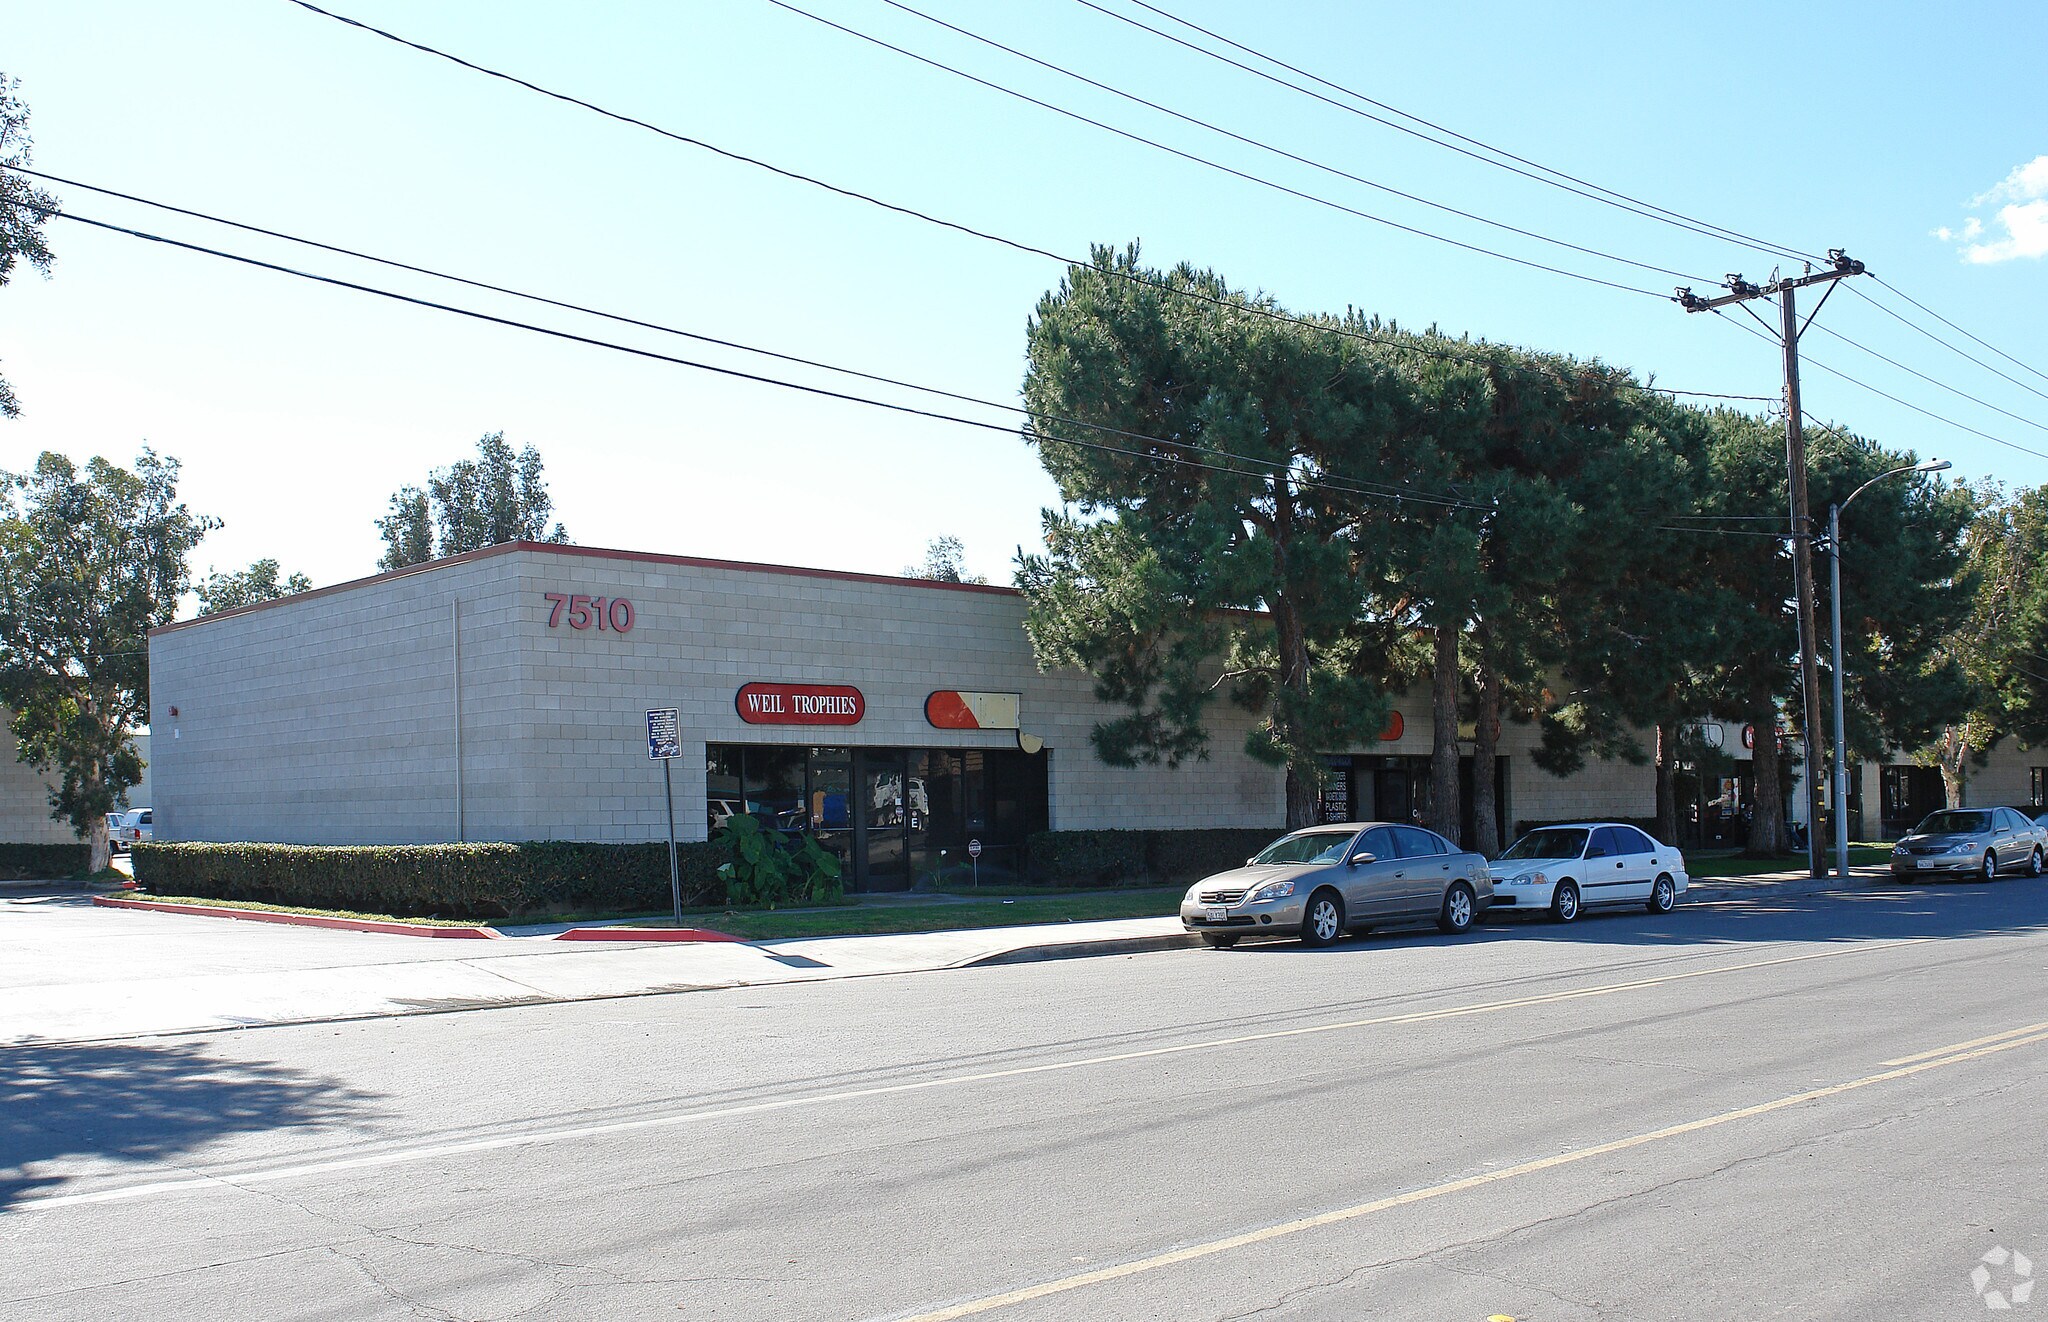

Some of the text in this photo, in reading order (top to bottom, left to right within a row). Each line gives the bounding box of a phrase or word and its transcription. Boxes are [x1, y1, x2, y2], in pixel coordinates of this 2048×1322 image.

[545, 593, 635, 633] 7510
[747, 694, 856, 715] WEIL TROPHIES
[1325, 802, 1347, 811] PLASTIC
[1325, 812, 1347, 821] T-SHIRTS
[911, 818, 918, 828] E
